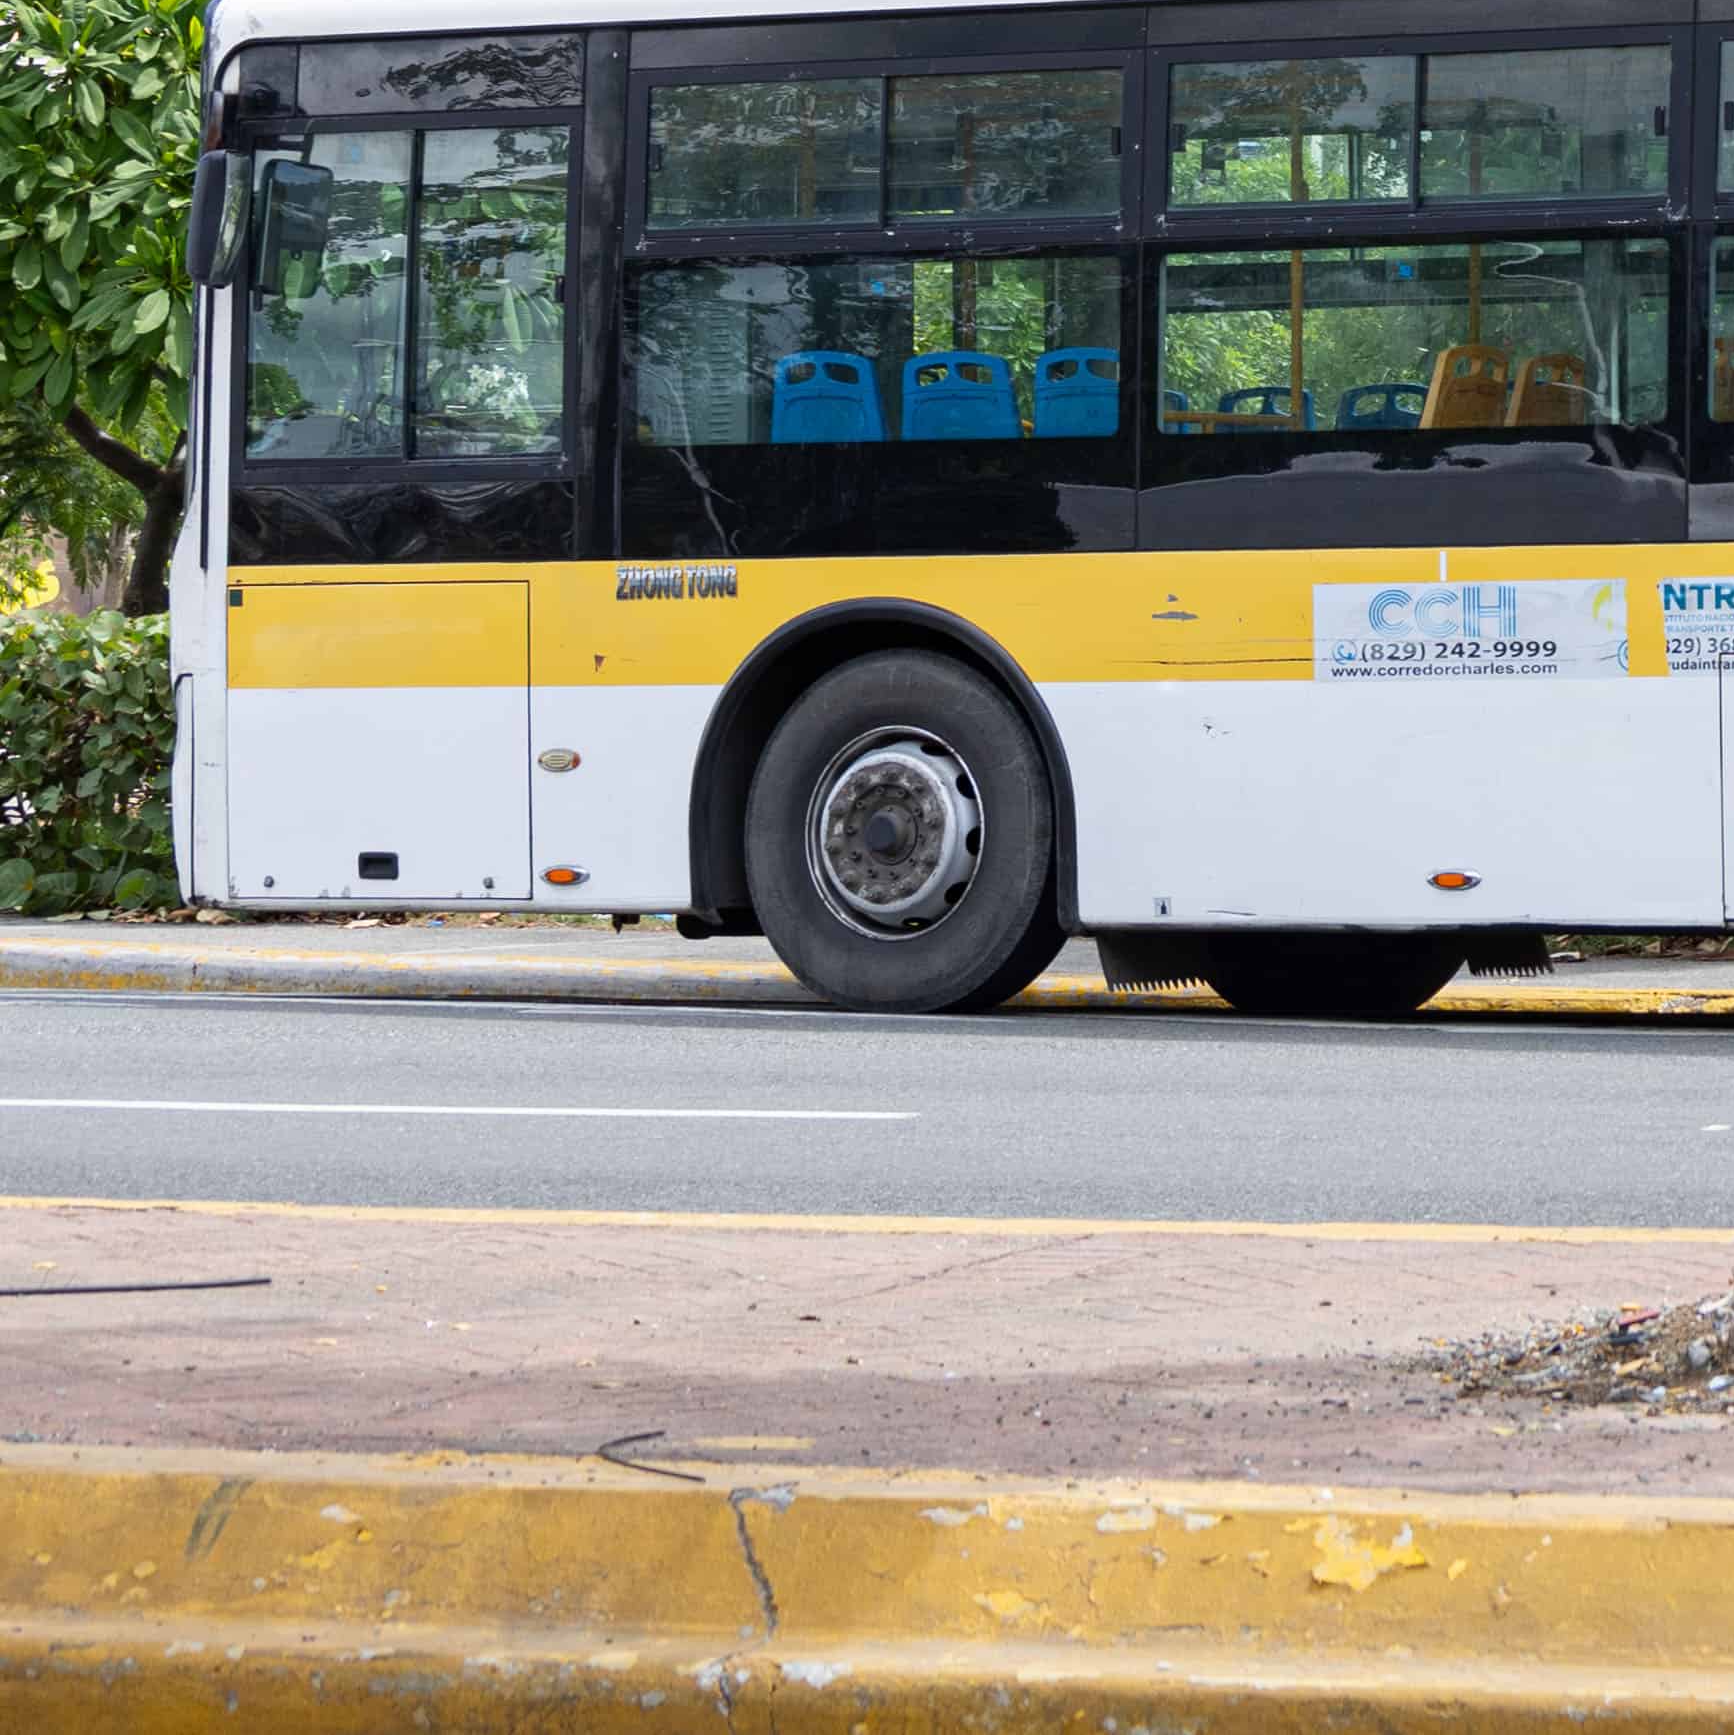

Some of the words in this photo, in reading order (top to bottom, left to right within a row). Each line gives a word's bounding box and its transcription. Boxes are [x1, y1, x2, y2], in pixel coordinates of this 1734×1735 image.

[616, 565, 683, 600] ZHONG
[685, 564, 738, 598] TONG
[1368, 585, 1517, 638] CCH
[1361, 642, 1426, 663] (829)
[1435, 640, 1558, 660] 242-9999
[1331, 662, 1558, 679] www.corredorcharles.com
